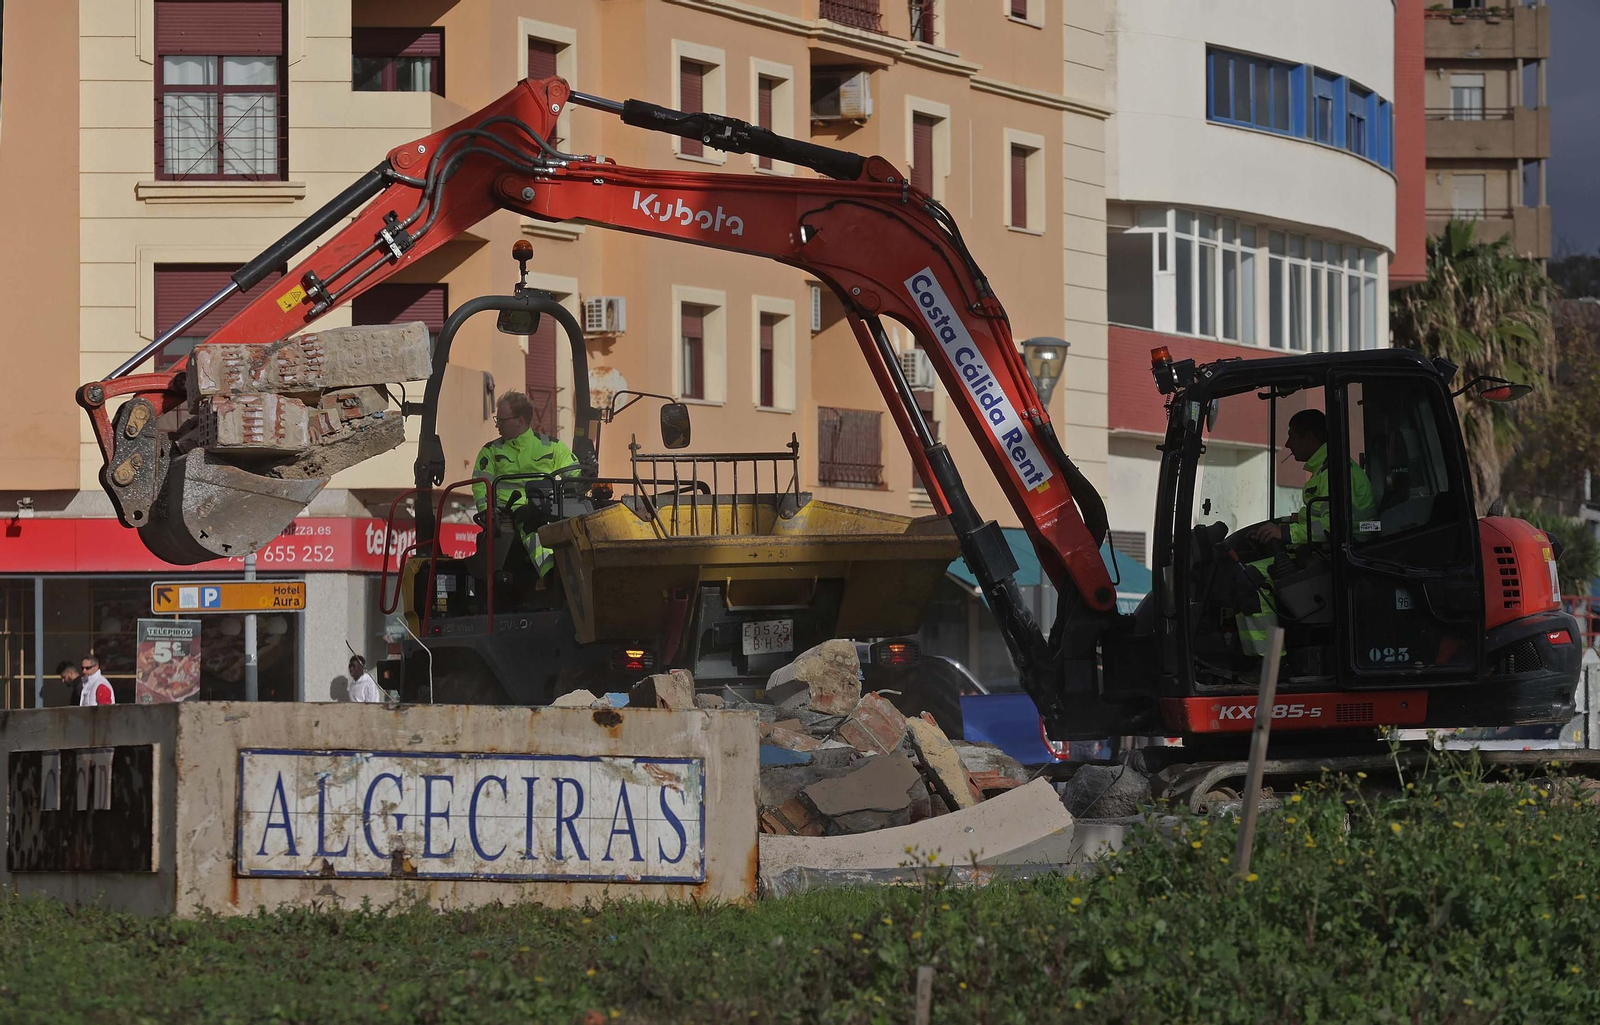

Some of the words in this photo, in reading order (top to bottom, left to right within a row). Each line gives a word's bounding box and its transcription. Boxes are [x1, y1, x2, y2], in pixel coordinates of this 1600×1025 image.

[632, 190, 744, 236] Kubota
[911, 274, 957, 345] Costa
[955, 346, 1006, 426] Cálida
[1002, 426, 1044, 485] Rent
[263, 545, 296, 562] 655
[302, 545, 335, 562] 252
[273, 585, 300, 595] Hotel
[272, 596, 300, 607] Aura
[146, 626, 193, 637] TELEPIBOX
[1219, 704, 1322, 720] KX85-5
[256, 769, 688, 865] ALGECIRAS
